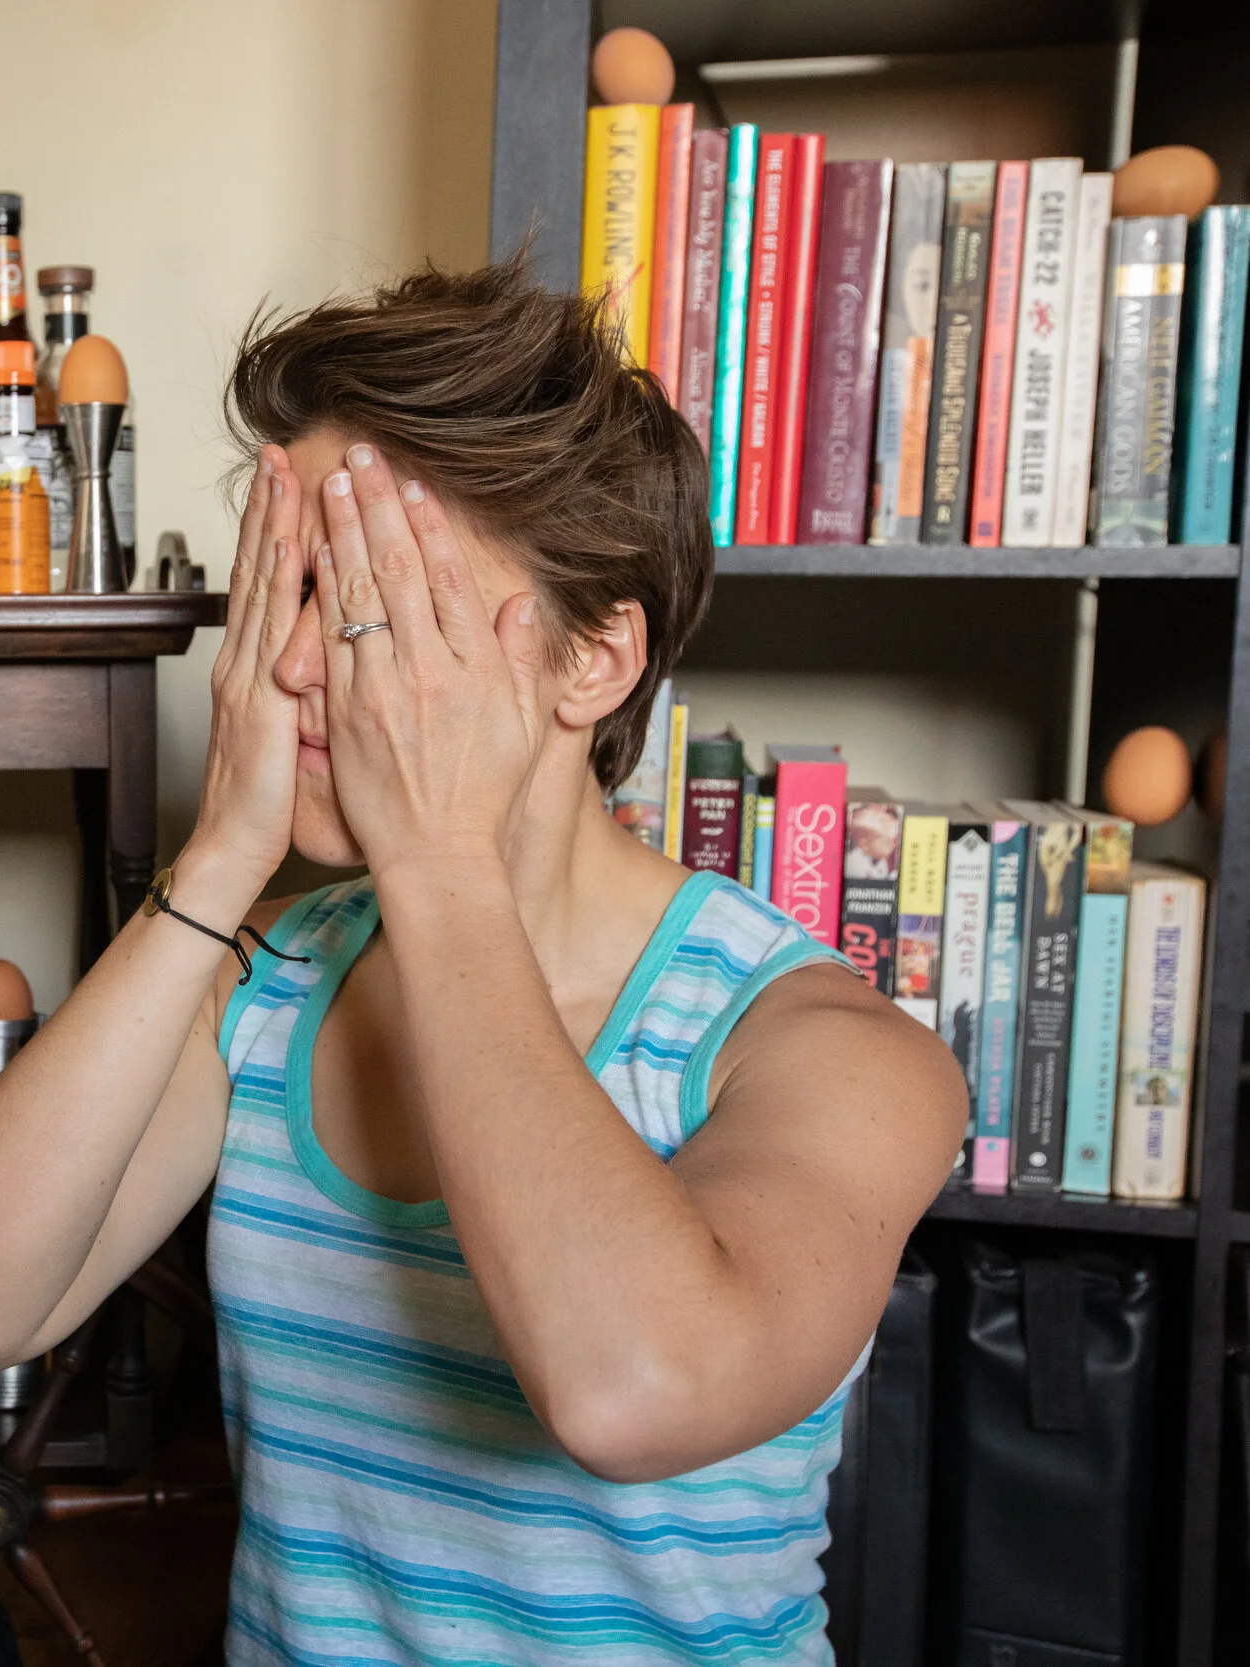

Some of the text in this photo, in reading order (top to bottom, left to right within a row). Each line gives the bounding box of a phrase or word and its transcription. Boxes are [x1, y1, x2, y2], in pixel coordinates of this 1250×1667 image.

[701, 159, 720, 186] Are
[766, 149, 783, 171] THE
[603, 122, 637, 267] J K ROWLING
[700, 189, 719, 219] You
[764, 173, 782, 233] ELEMENTS
[693, 218, 716, 246] My
[762, 234, 778, 251] OF
[1033, 190, 1066, 287] CATCH-22
[759, 252, 776, 288] STYLE
[841, 247, 862, 276] THE
[757, 302, 774, 345] STRUNK
[754, 355, 769, 392] WHITE
[942, 323, 972, 396] THOUSAND
[829, 375, 856, 437] MONTE
[1024, 346, 1052, 422] JOSEPH
[1109, 299, 1144, 494] AMERICAN GODS
[1144, 316, 1176, 476] NEIL GAIMAN
[937, 396, 966, 466] SPLENDID
[825, 440, 850, 504] CRISTO
[934, 465, 961, 504] SUNS
[1019, 428, 1047, 496] HELLER
[691, 797, 736, 810] PETER
[700, 810, 727, 822] PAN
[788, 802, 837, 938] Sextrol
[993, 852, 1020, 897] THE
[846, 887, 896, 901] JONATHAN
[847, 901, 893, 915] FRANZEN
[954, 891, 979, 979] prague
[986, 958, 1013, 1003] JAR
[1034, 935, 1052, 989] DAWN
[1050, 931, 1069, 995] SEX AT
